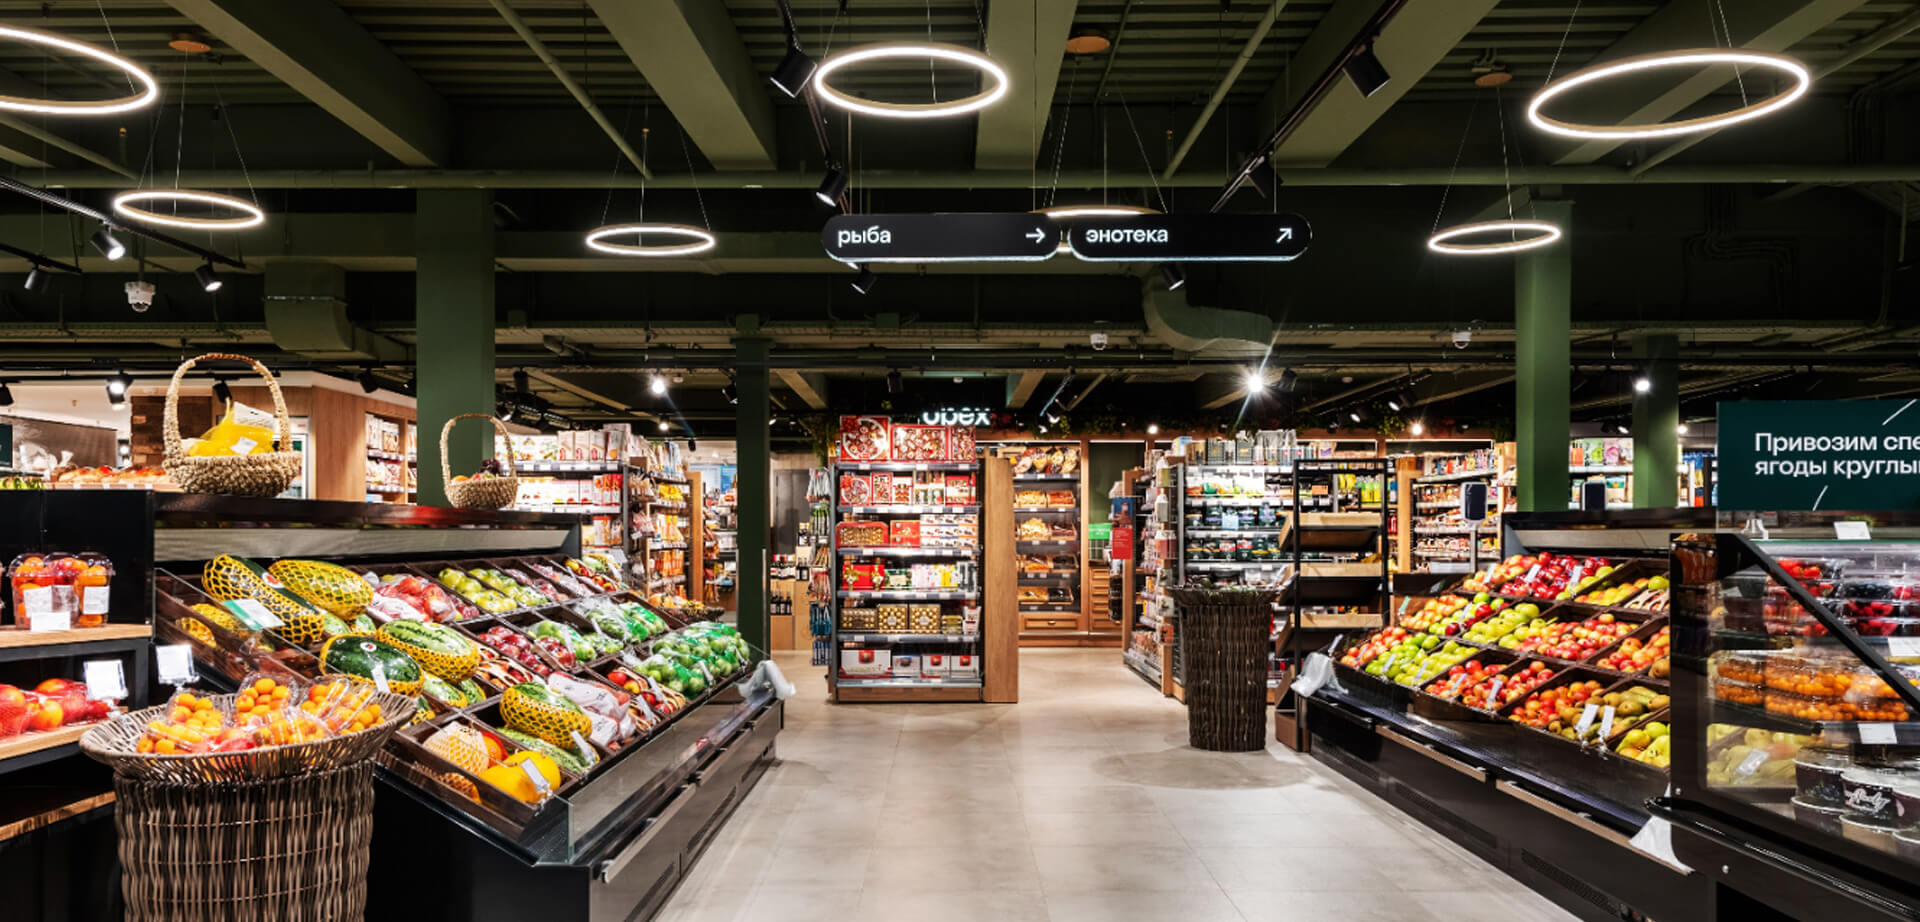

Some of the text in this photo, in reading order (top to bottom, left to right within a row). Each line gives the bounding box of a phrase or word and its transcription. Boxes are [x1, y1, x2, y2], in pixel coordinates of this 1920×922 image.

[837, 225, 892, 247] рыба
[1086, 227, 1169, 243] энотека
[1755, 432, 1877, 456] Привозим
[1755, 459, 1920, 479] ягоды круглы
